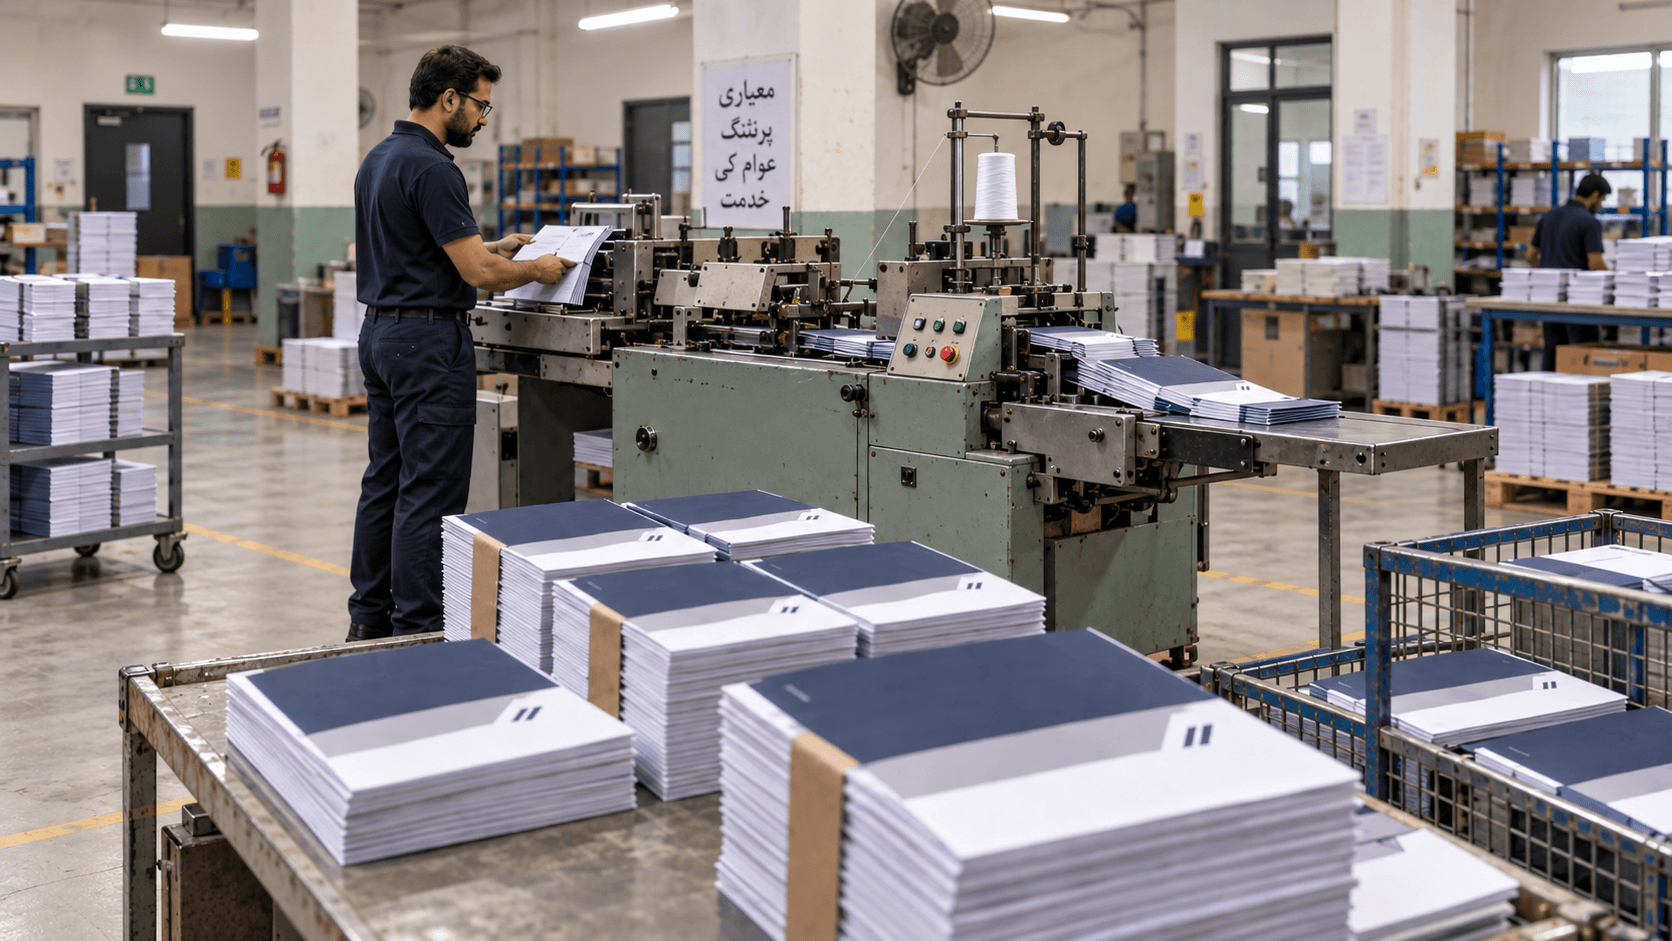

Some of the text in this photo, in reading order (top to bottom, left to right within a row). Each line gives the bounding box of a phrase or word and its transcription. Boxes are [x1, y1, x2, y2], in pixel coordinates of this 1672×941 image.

[718, 80, 775, 108] معیاری
[715, 152, 776, 184] عوام کی
[720, 190, 770, 209] خدمت
